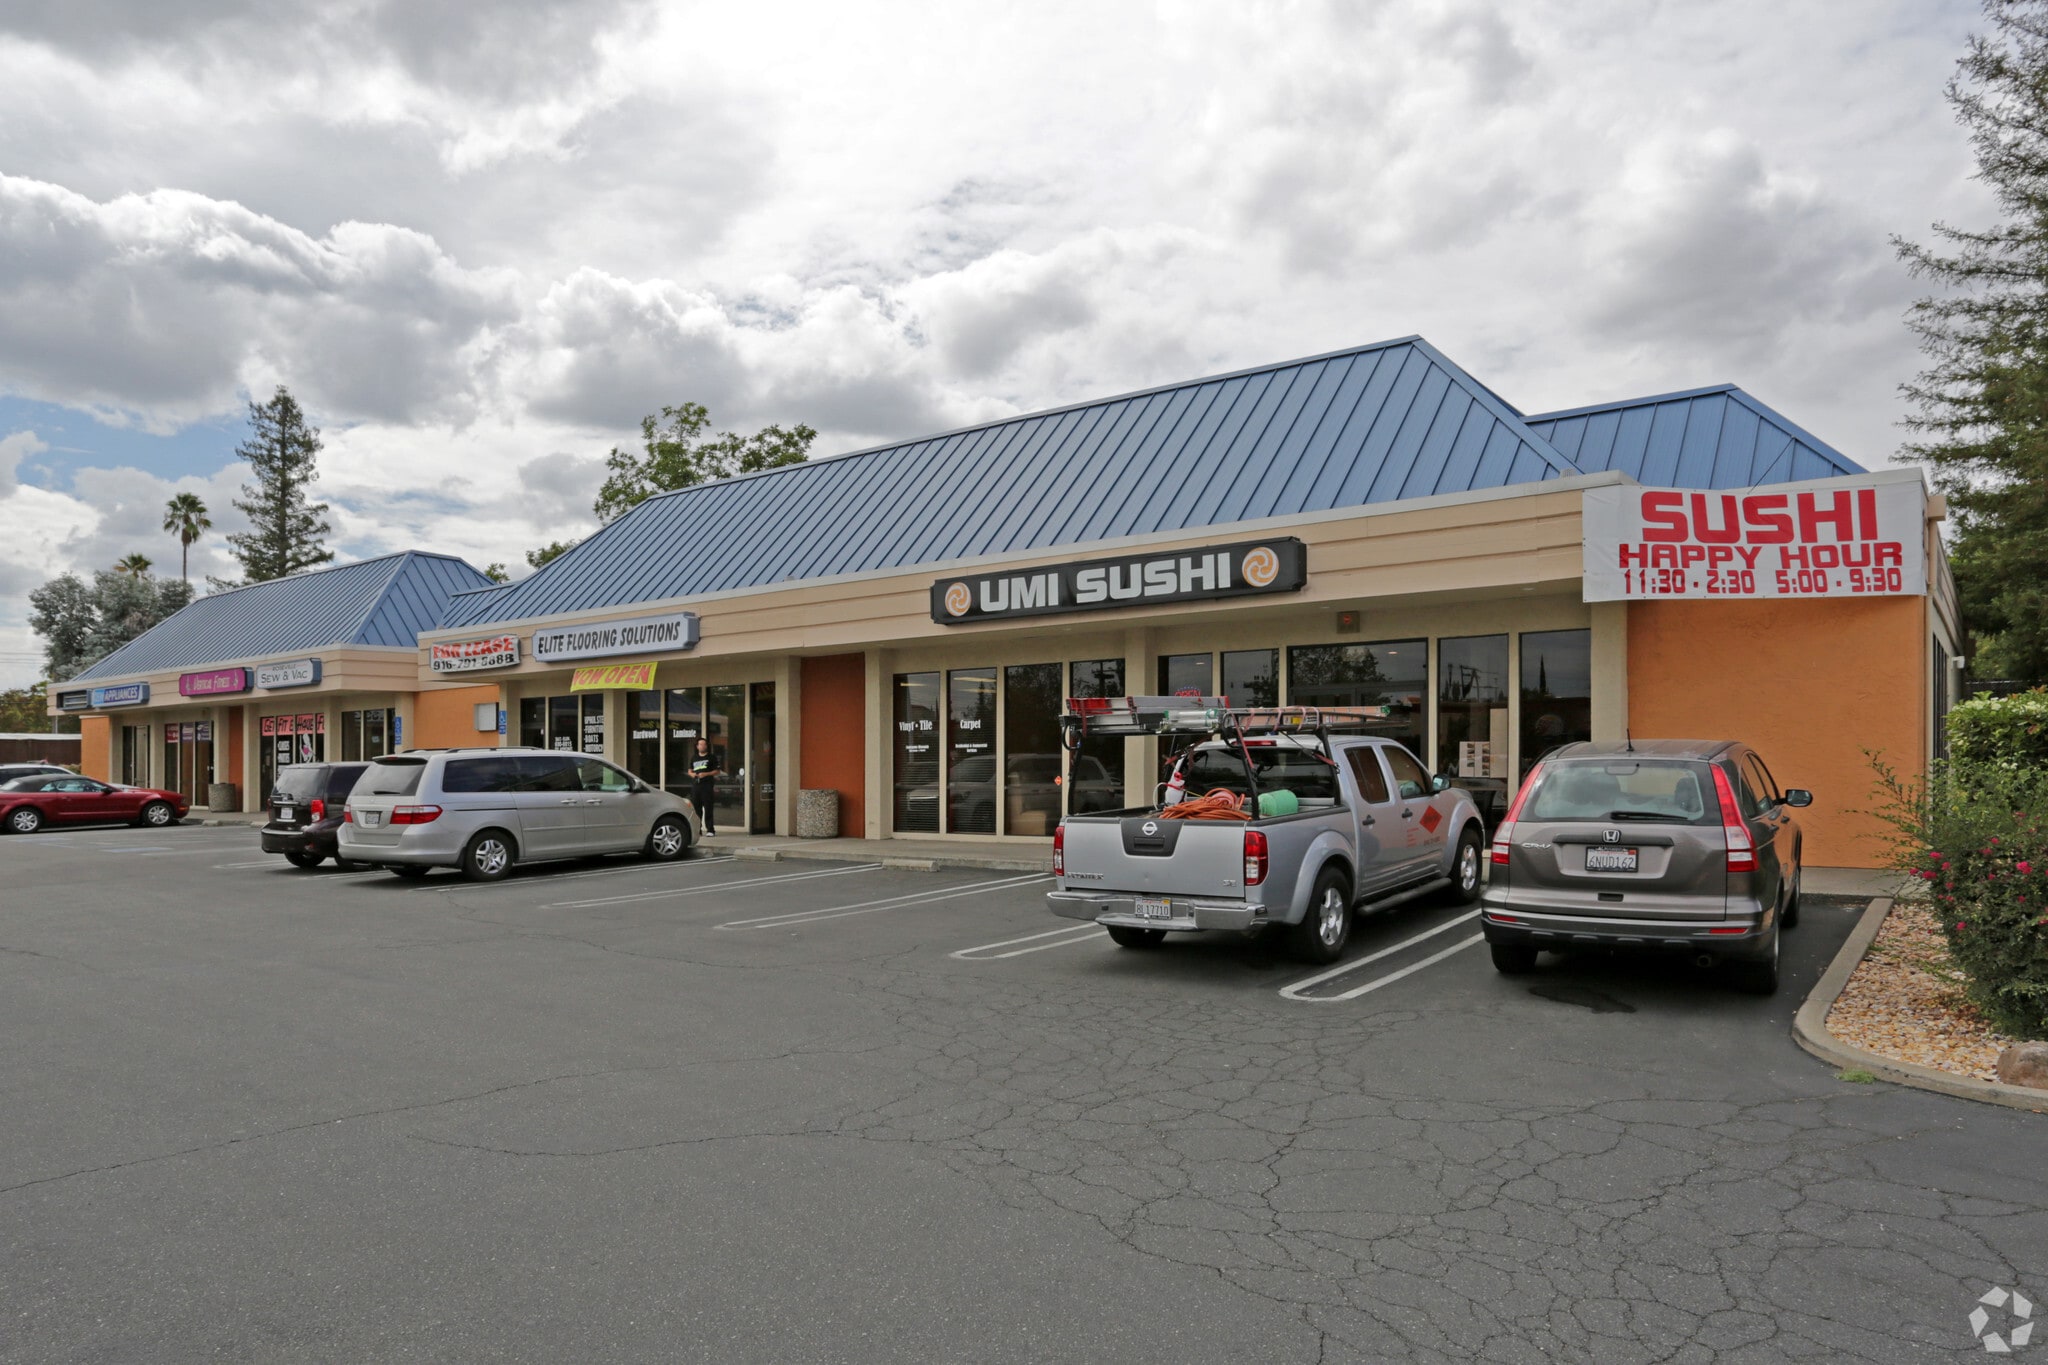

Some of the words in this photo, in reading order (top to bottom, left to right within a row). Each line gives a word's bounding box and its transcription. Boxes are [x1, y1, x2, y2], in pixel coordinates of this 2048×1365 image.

[1641, 489, 1878, 544] SUSHI
[1619, 543, 1762, 569] HAPPY
[1779, 542, 1902, 569] HOUR
[979, 573, 1059, 612] UMI
[1075, 552, 1231, 604] SUSHI
[1624, 569, 1686, 594] 11:30
[1706, 570, 1755, 594] 2:30
[1775, 569, 1828, 593] 5:00
[1849, 567, 1902, 592] 9:30
[464, 637, 515, 657] LEASE
[538, 634, 564, 654] ELITE
[566, 628, 617, 652] FLOORING
[620, 621, 681, 646] SOLUTIONS
[573, 667, 608, 687] NOW
[605, 664, 653, 684] OPEN
[104, 686, 138, 702] APPLIANCES
[633, 729, 658, 739] Hardwood
[672, 728, 696, 738] Laminate
[919, 719, 933, 731] Tile
[960, 719, 981, 730] Carpet
[1588, 855, 1634, 869] 6NUD162
